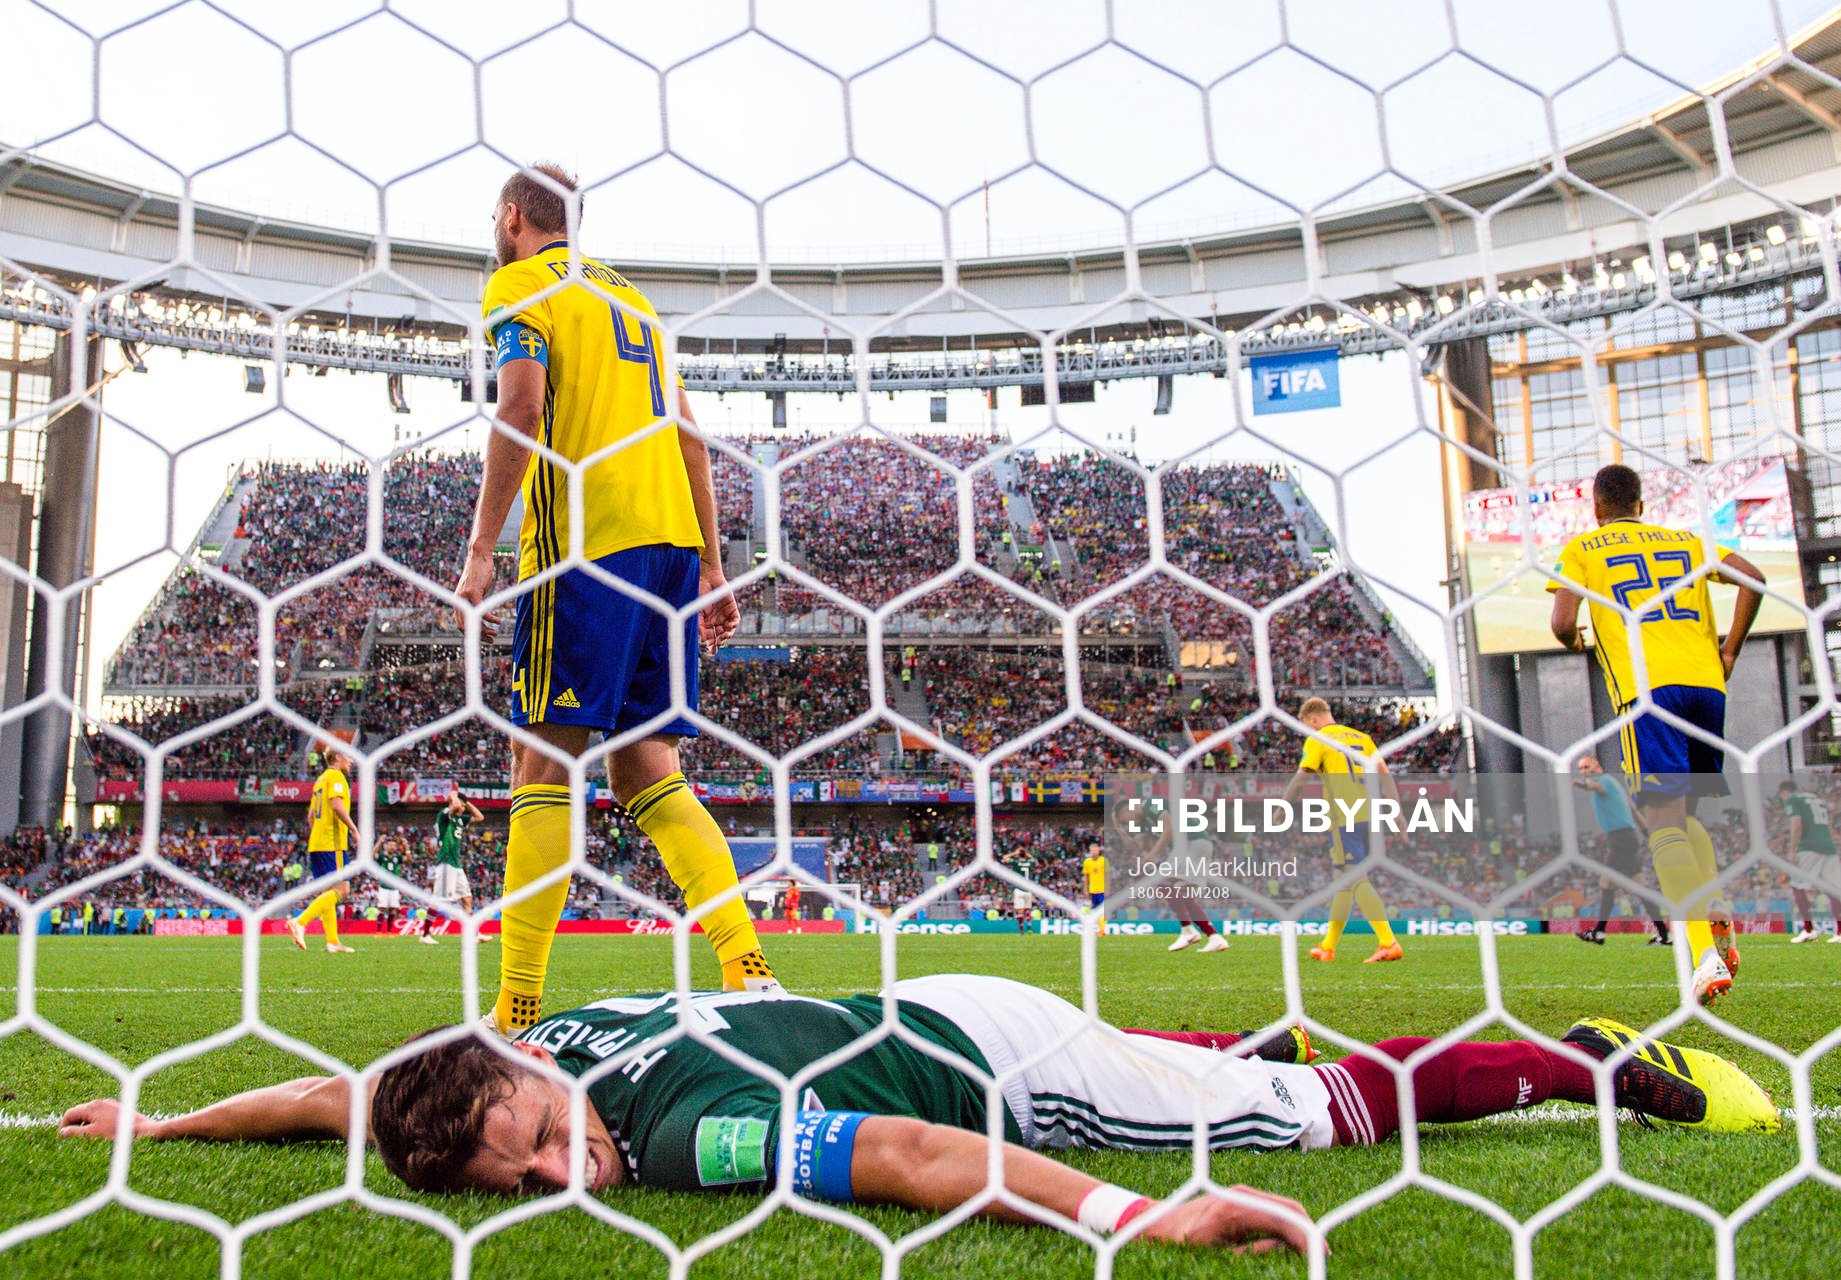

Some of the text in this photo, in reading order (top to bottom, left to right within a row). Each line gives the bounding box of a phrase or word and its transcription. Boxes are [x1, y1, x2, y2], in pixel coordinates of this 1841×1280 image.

[608, 300, 667, 418] 4
[1263, 368, 1327, 398] FIFA
[1605, 550, 1700, 625] 22
[512, 662, 528, 713] 4
[553, 699, 580, 708] adidas
[393, 919, 450, 935] Bd
[1040, 919, 1154, 935] Hisnse
